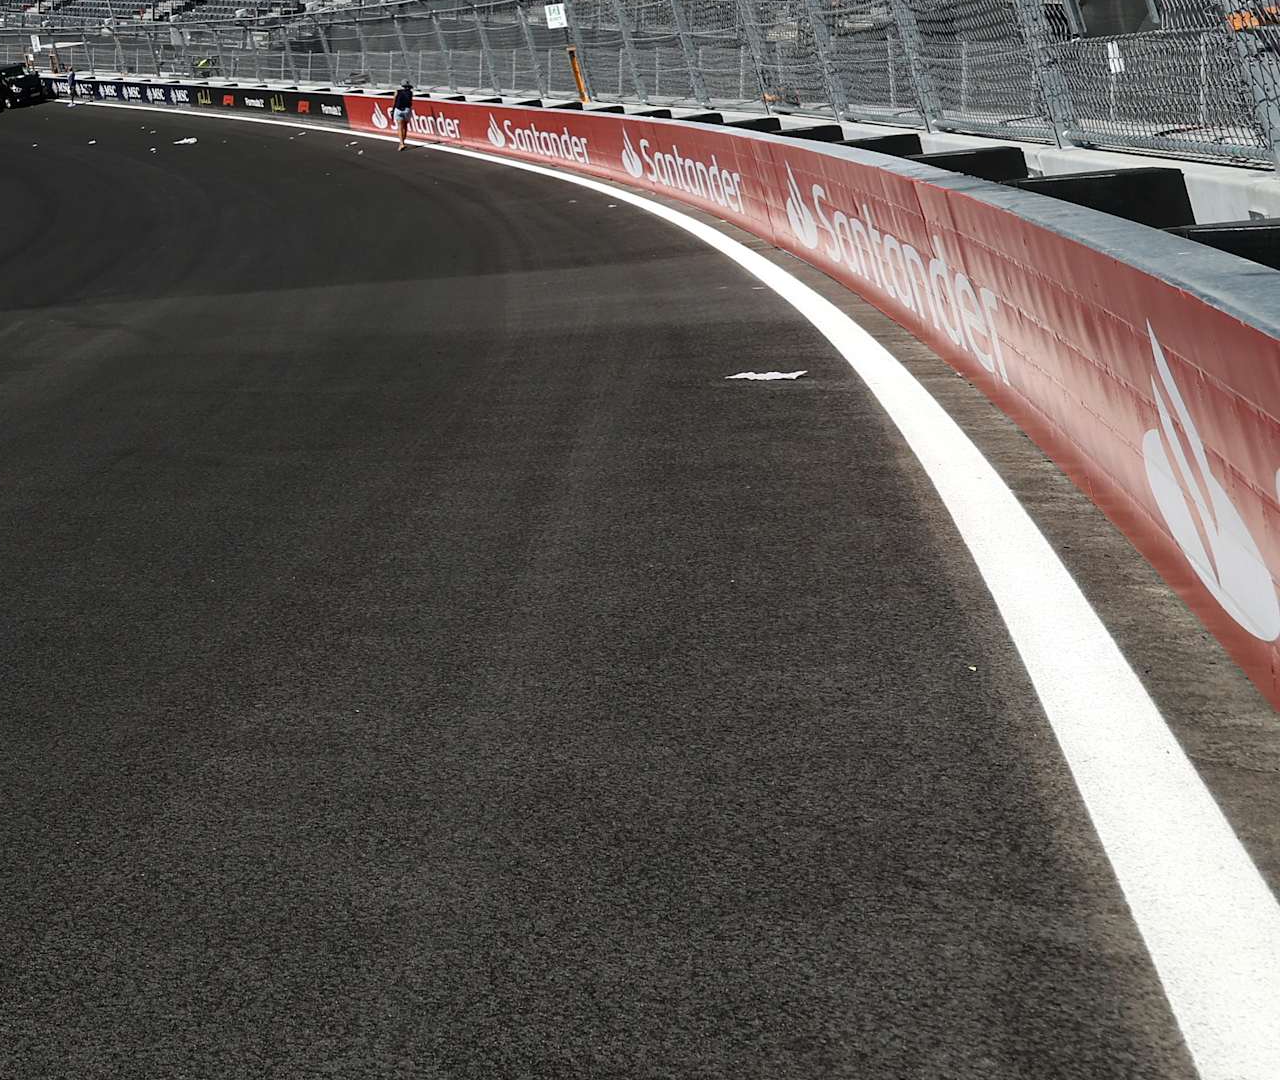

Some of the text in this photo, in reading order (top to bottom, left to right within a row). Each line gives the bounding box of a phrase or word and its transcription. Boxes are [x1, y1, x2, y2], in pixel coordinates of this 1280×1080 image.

[103, 85, 117, 97] MSC
[127, 86, 141, 98] MSC
[151, 88, 166, 100] MSC
[175, 89, 189, 102] MSC
[387, 107, 460, 139] Sntander
[504, 119, 590, 164] Santander
[639, 138, 744, 215] Santander
[811, 184, 1009, 386] Santander
